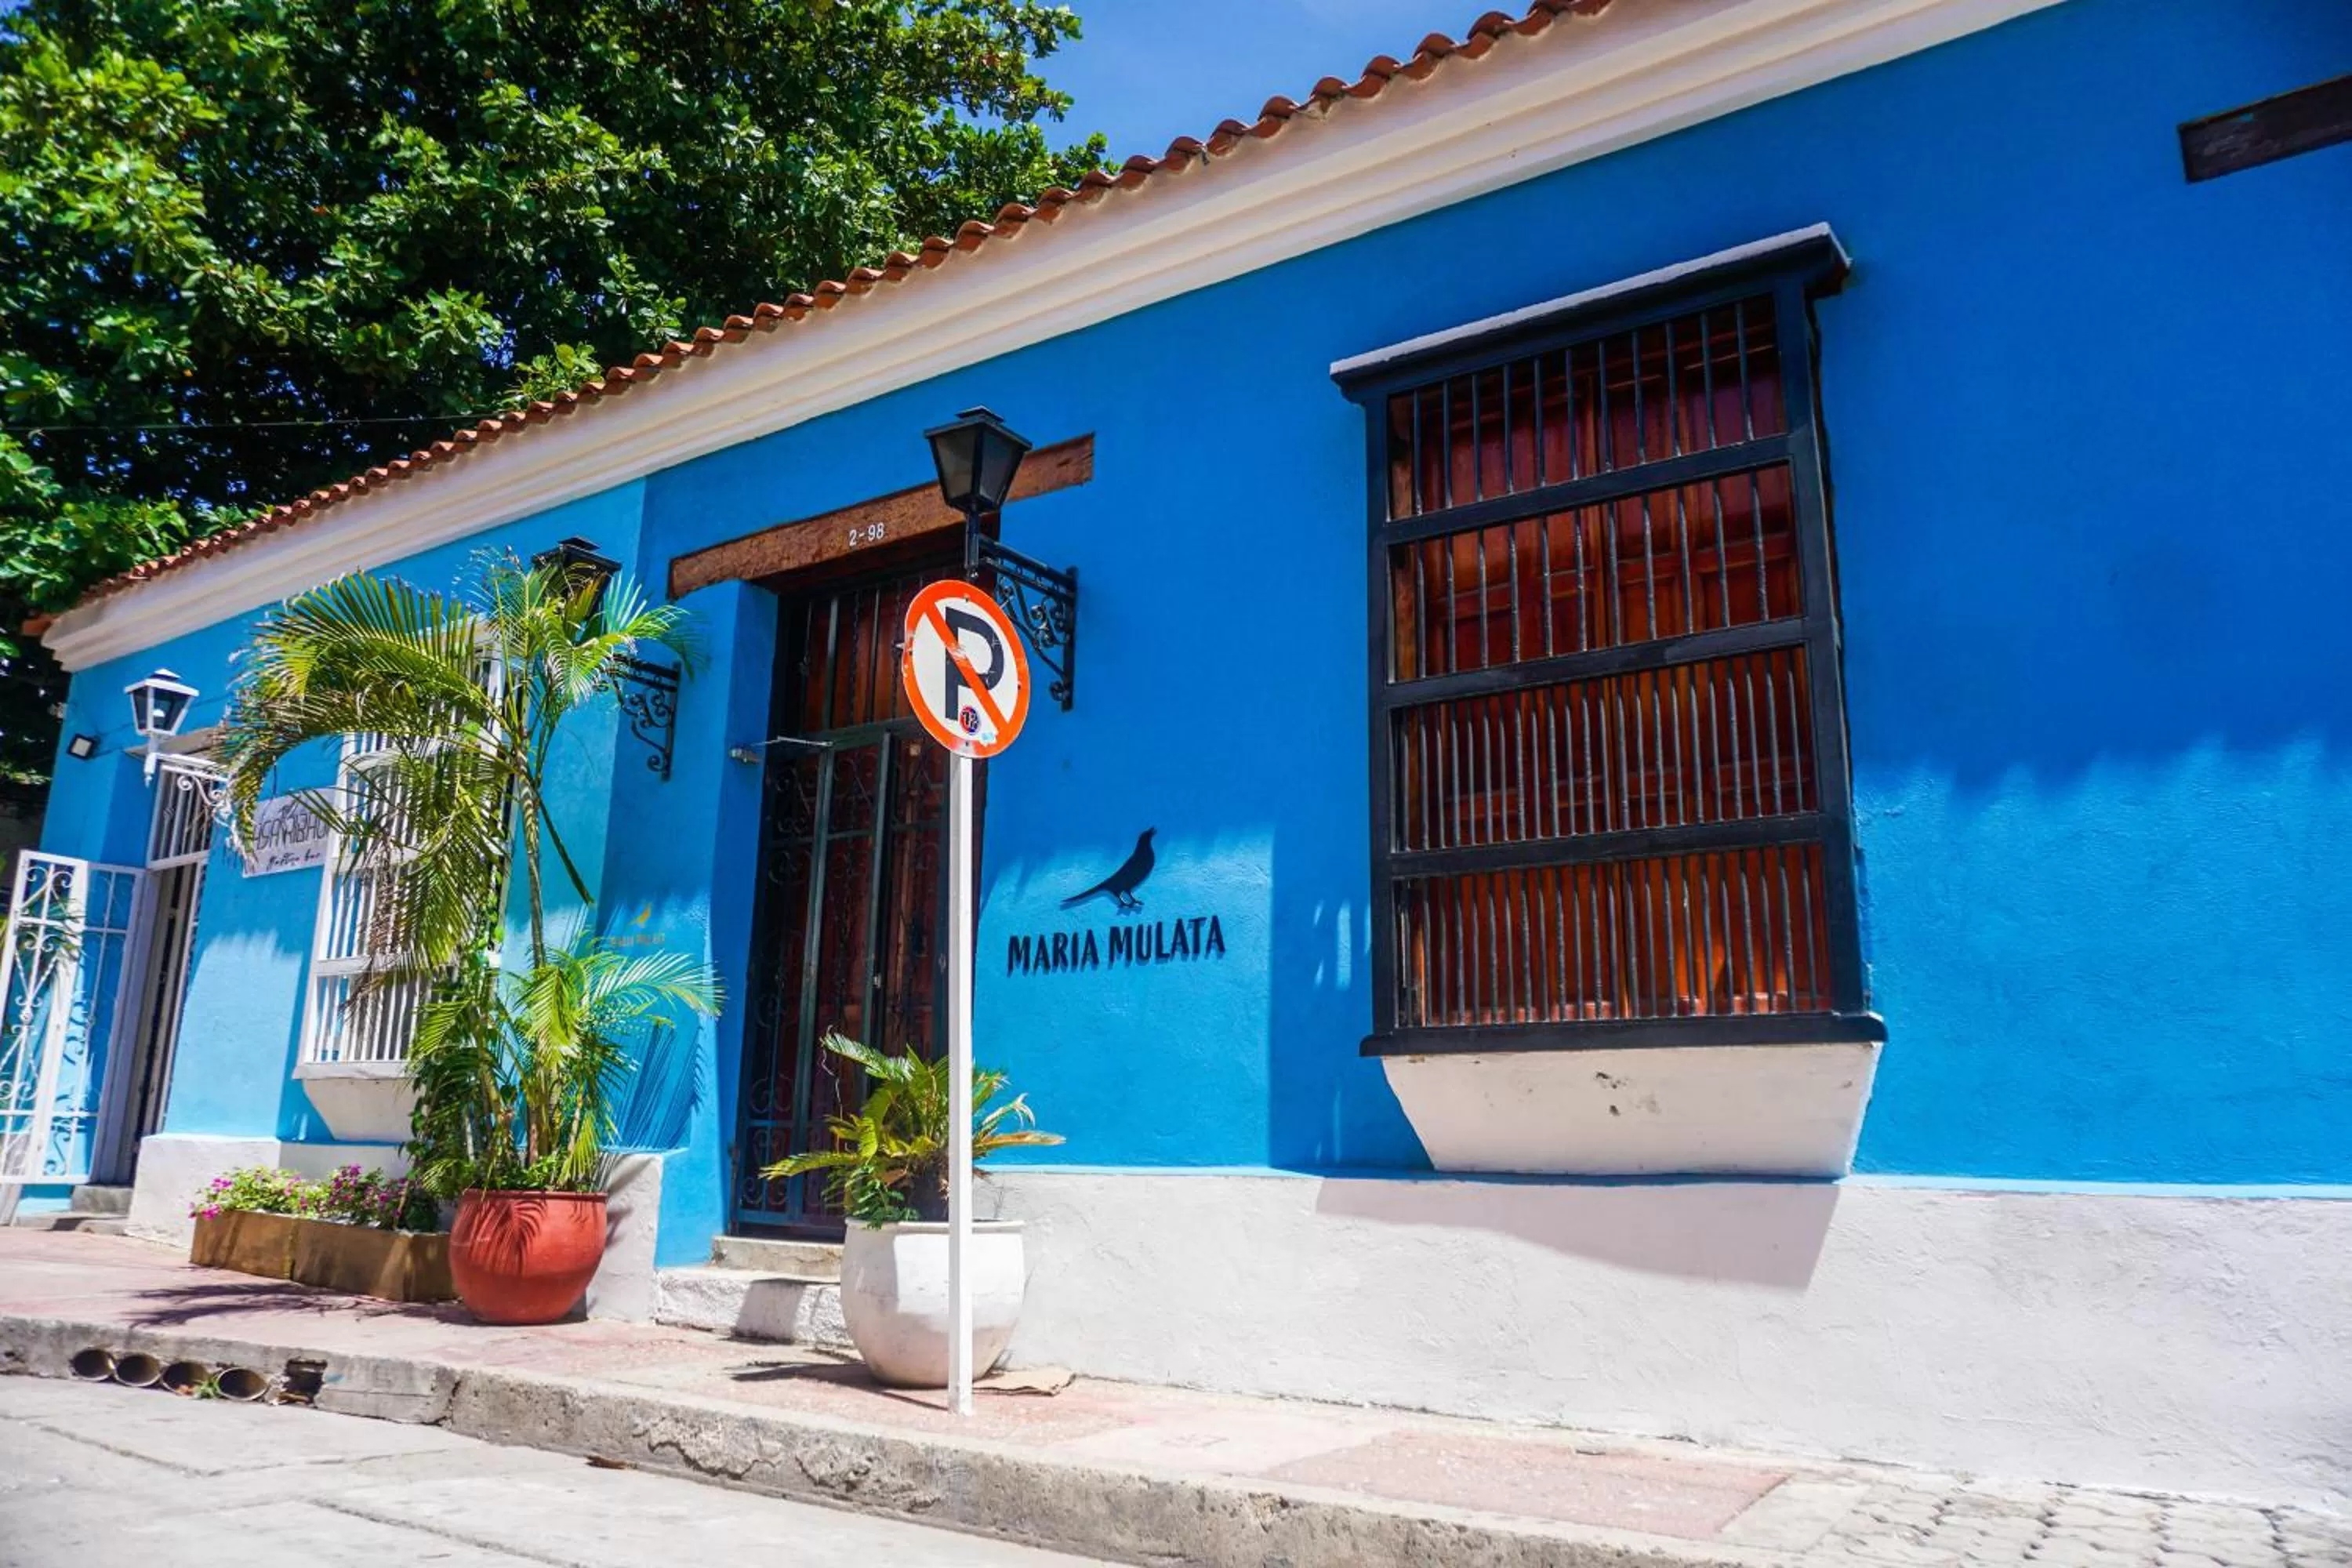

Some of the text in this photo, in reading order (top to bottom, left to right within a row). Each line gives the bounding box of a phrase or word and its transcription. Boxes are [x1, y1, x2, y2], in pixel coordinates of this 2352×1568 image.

[849, 521, 884, 546] 2-98
[945, 606, 1004, 722] P
[1007, 915, 1226, 977] MARIA MULATA
